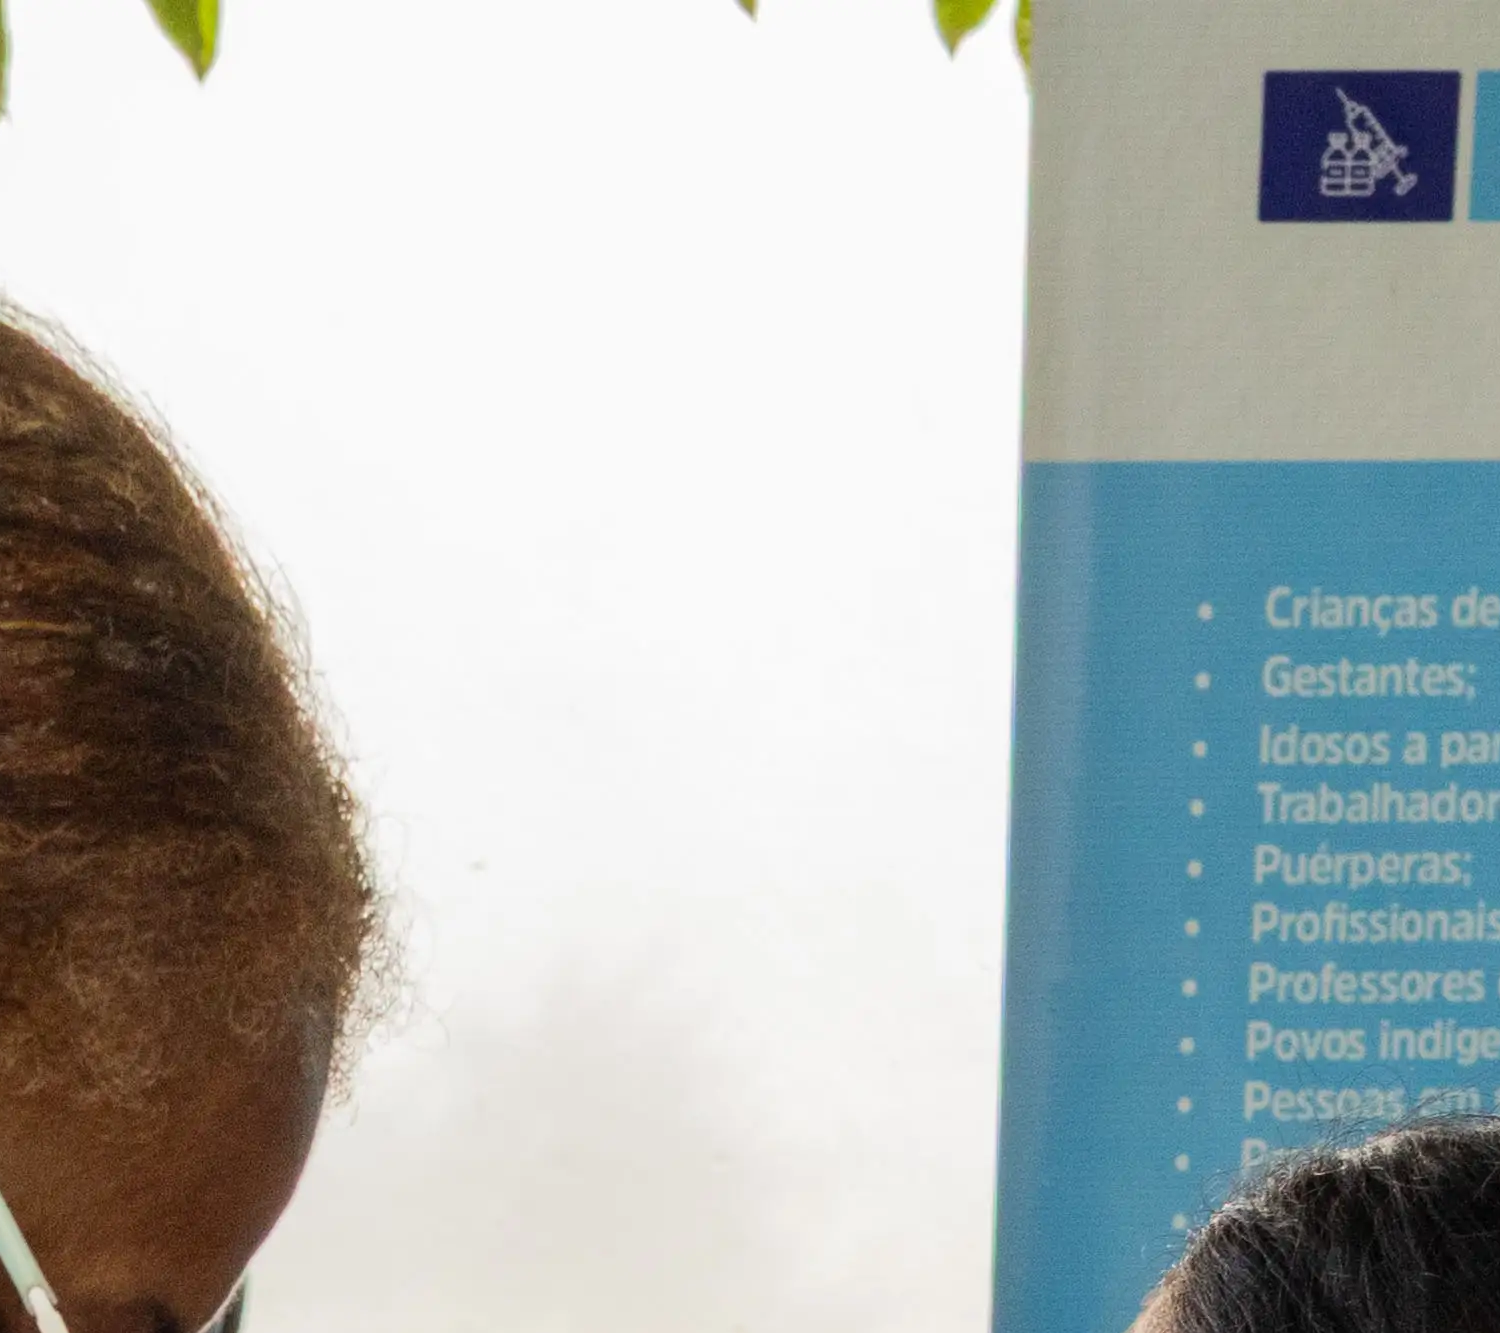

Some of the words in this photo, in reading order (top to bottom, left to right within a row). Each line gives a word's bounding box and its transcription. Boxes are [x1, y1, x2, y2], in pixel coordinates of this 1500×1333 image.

[1265, 585, 1440, 636] Crianças
[1262, 653, 1476, 699] Gestantes;
[1259, 723, 1391, 766] Idosos
[1402, 731, 1428, 765] a
[1254, 842, 1472, 890] Puérperas;
[1248, 960, 1490, 1005] Professores
[1246, 1019, 1367, 1063] Povos
[1243, 1080, 1404, 1121] Pessoas
